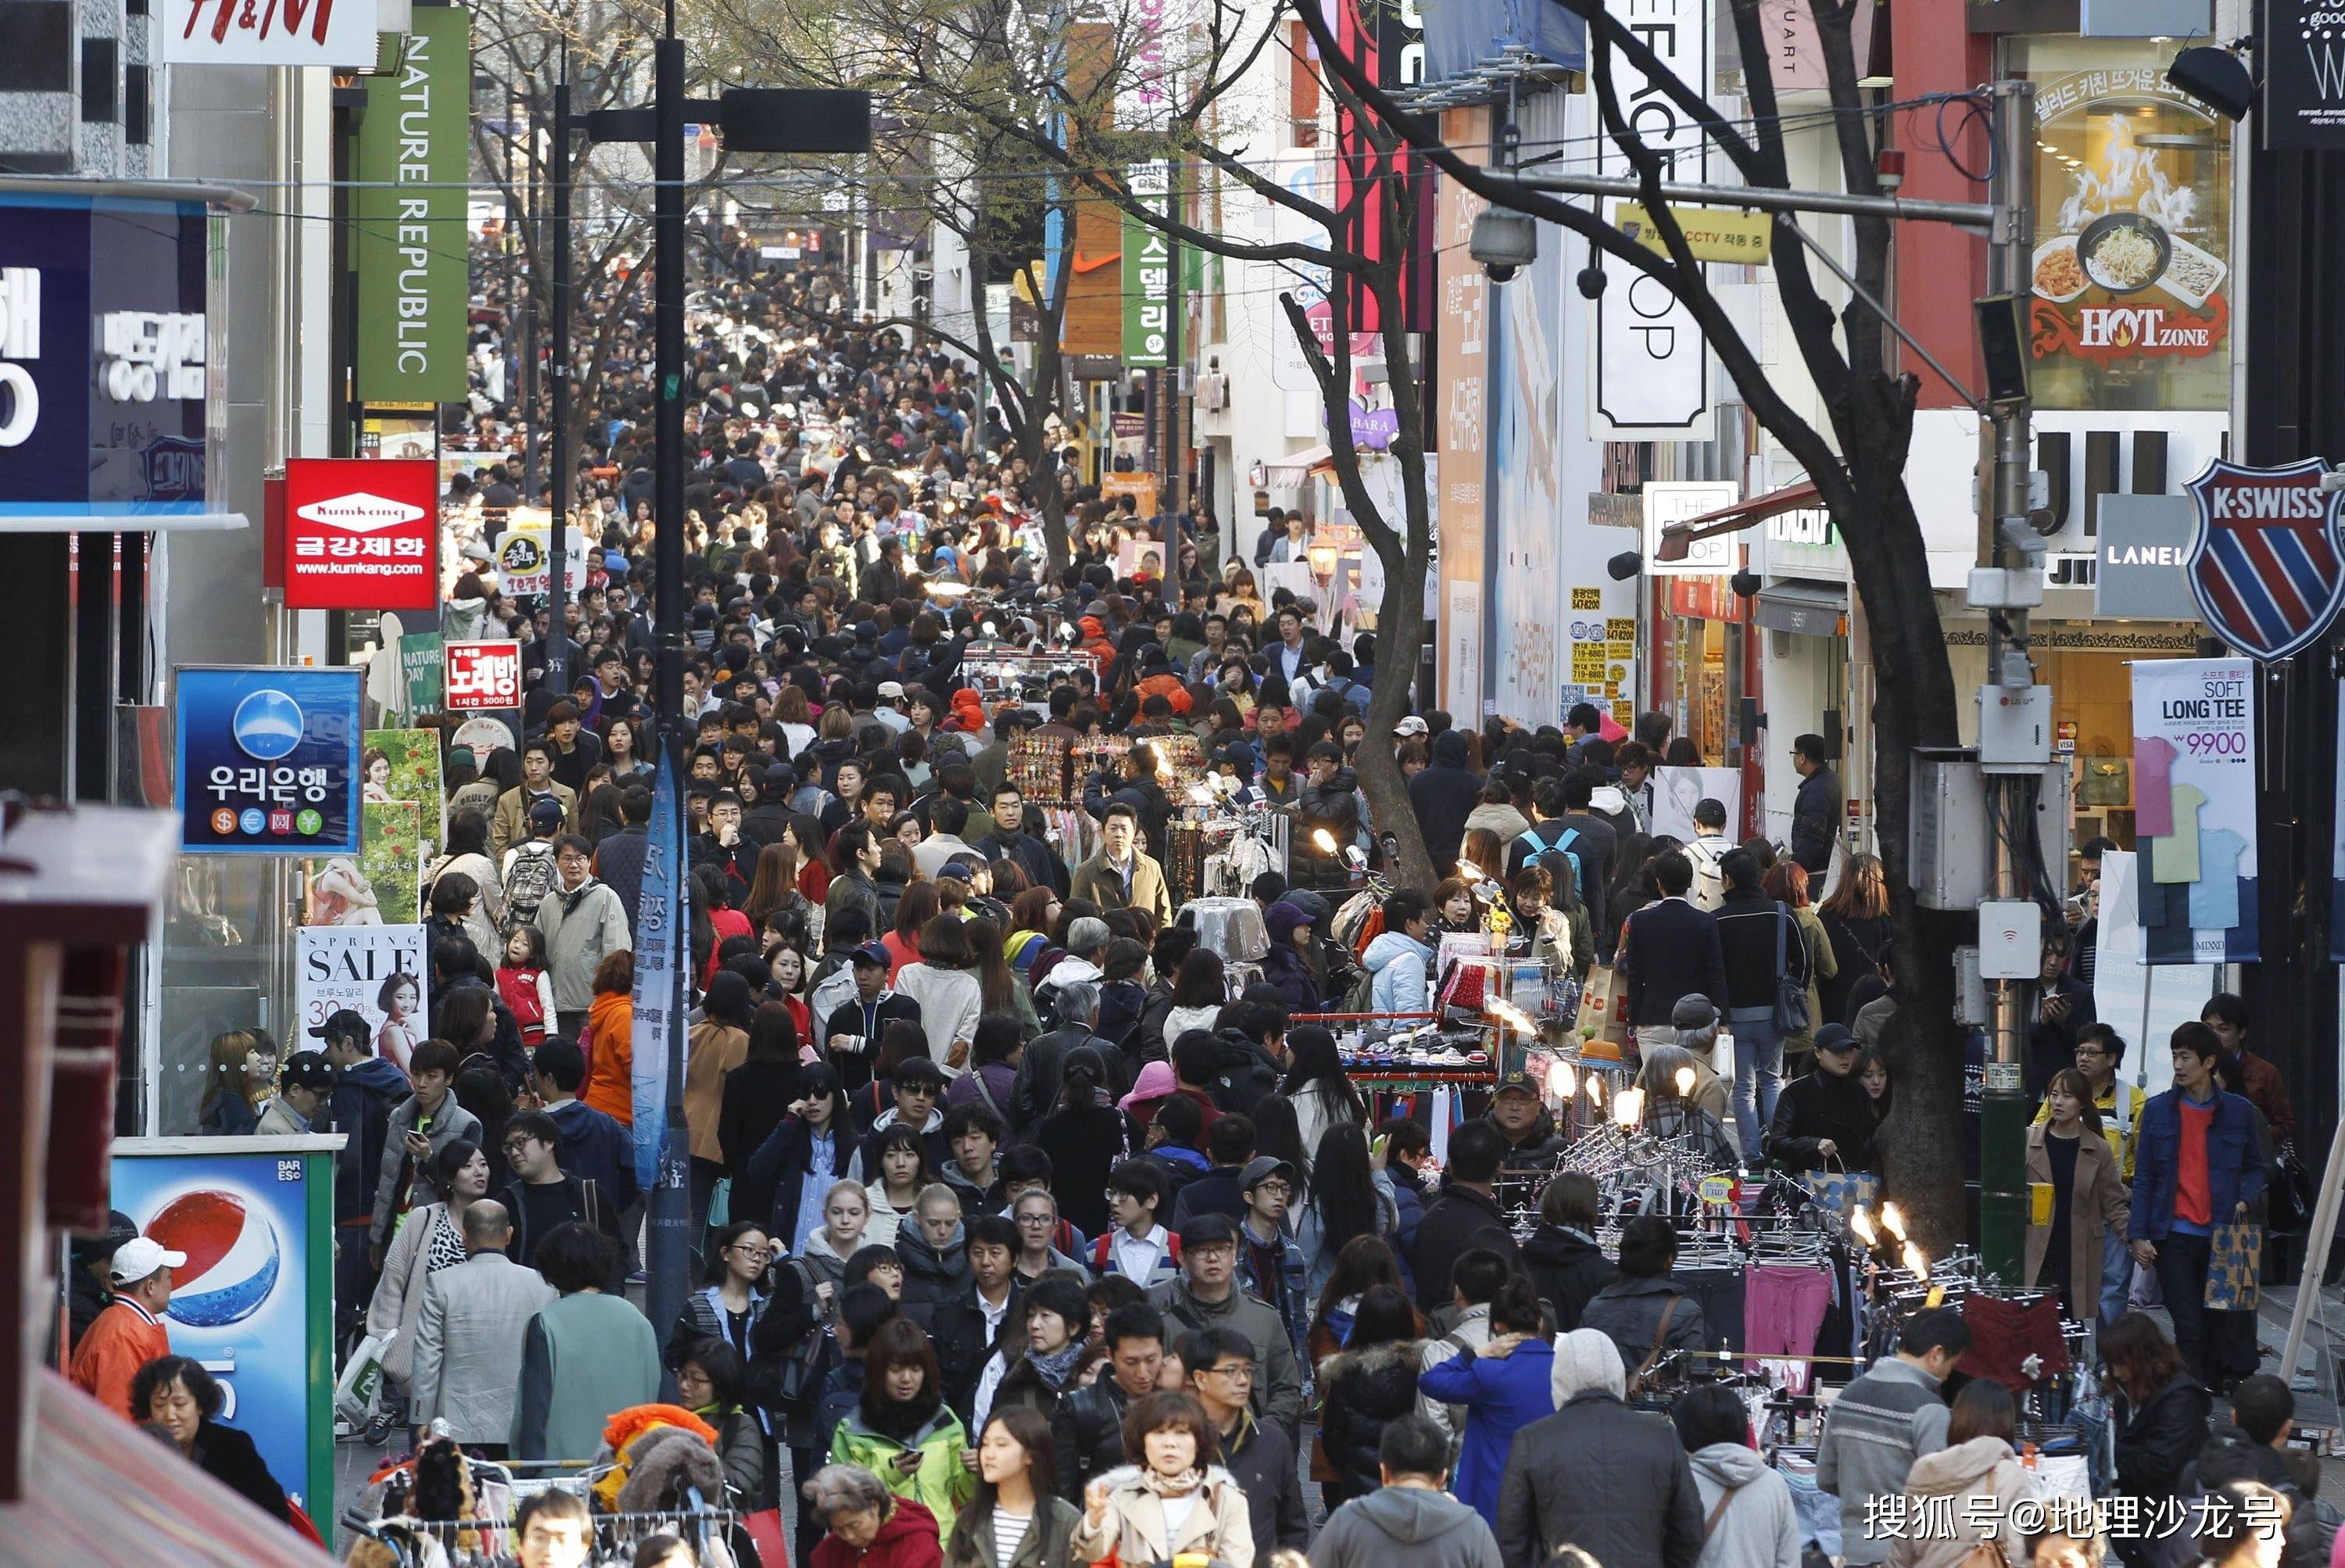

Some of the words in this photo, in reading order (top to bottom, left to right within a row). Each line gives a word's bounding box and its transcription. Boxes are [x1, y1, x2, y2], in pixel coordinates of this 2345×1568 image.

[2079, 72, 2108, 98] 키친
[2111, 68, 2154, 92] 뜨거운
[399, 36, 429, 181] NATURE
[1684, 231, 1720, 243] CCTV
[399, 199, 429, 374] REPUBLIC
[2079, 308, 2164, 347] HOT
[2159, 329, 2209, 346] ZONE
[295, 537, 426, 557] 금강제화
[295, 562, 424, 577] www.kumkang.com
[404, 650, 439, 666] NATURE
[449, 655, 517, 696] 노래방
[2205, 682, 2244, 698] SOFT
[2163, 700, 2210, 719] LONG
[2213, 699, 2246, 718] TEE
[207, 766, 328, 803] 우리은행
[309, 936, 417, 947] SPRING
[2196, 941, 2225, 950] MIXXO
[308, 949, 420, 983] SALE
[277, 1160, 301, 1171] BAR
